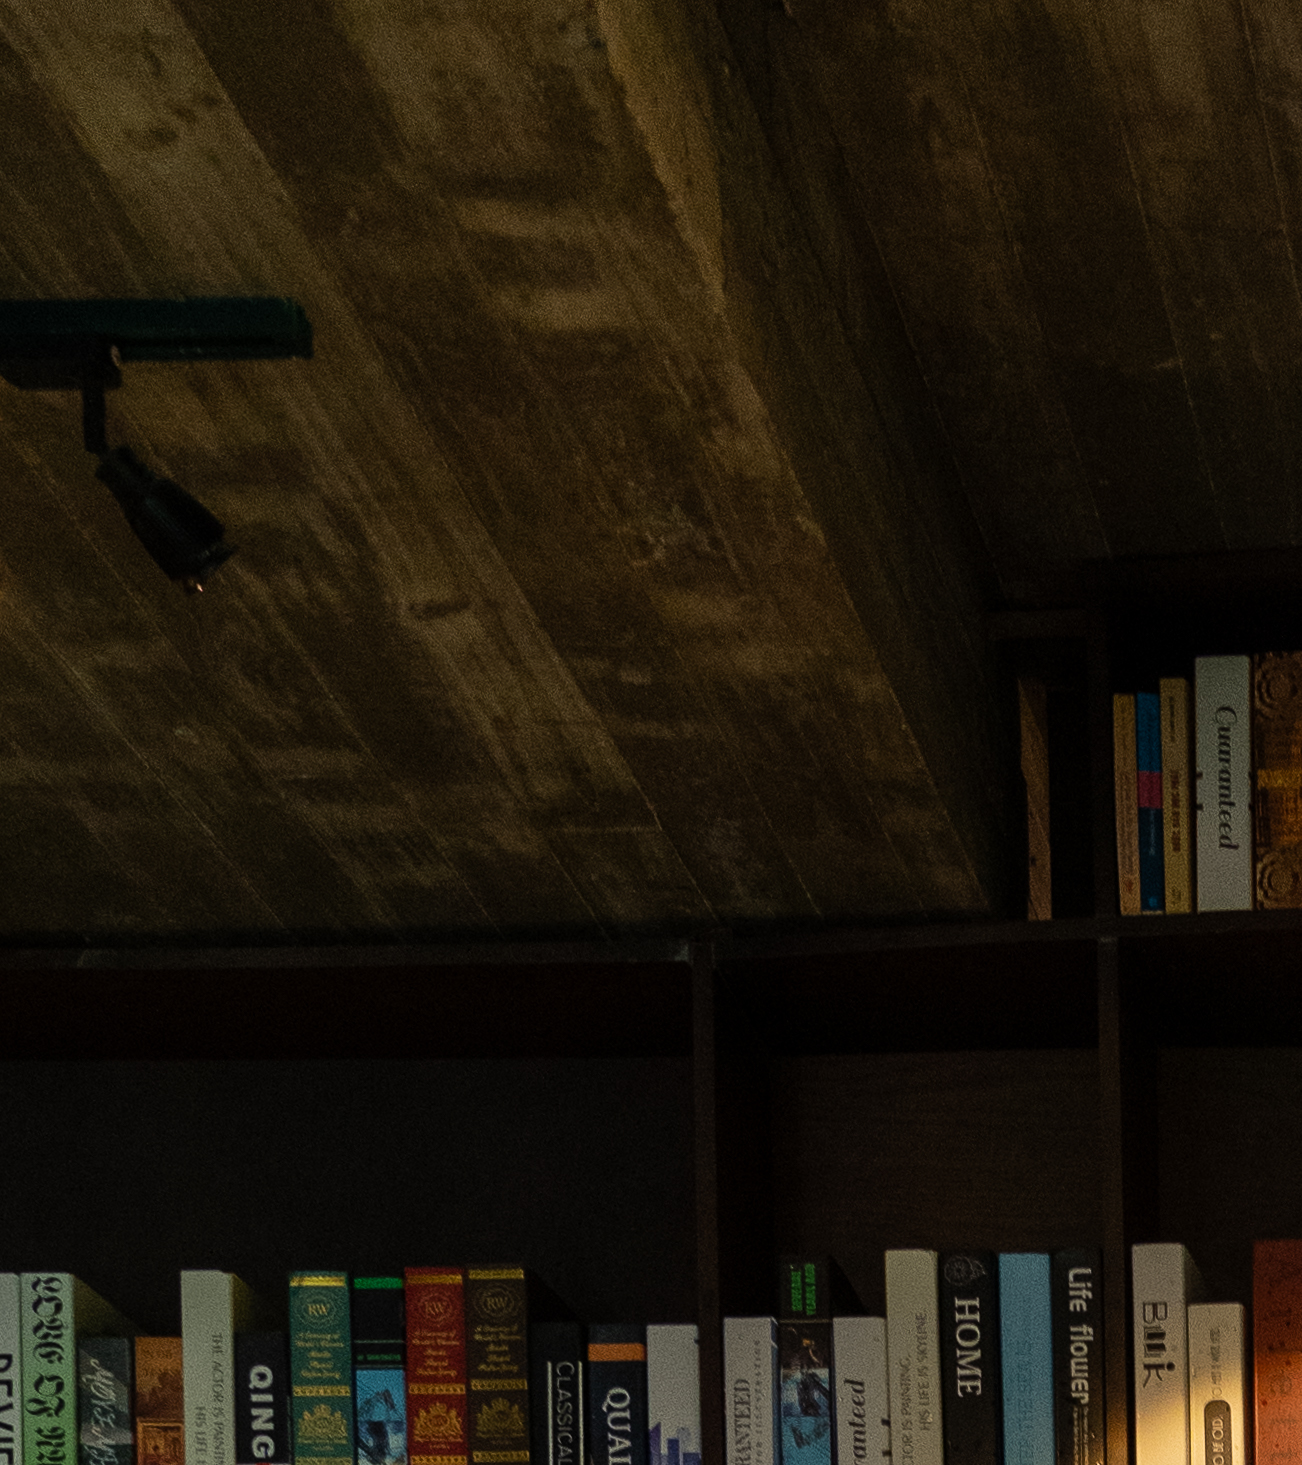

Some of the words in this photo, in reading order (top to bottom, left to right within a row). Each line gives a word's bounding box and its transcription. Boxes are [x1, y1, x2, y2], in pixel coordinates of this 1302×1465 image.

[1215, 704, 1241, 851] Guaranteed
[1069, 1266, 1095, 1313] Life
[953, 1295, 983, 1399] HOME
[1069, 1323, 1095, 1405] flower
[213, 1361, 226, 1403] ACTOR
[194, 1432, 208, 1454] LIFE
